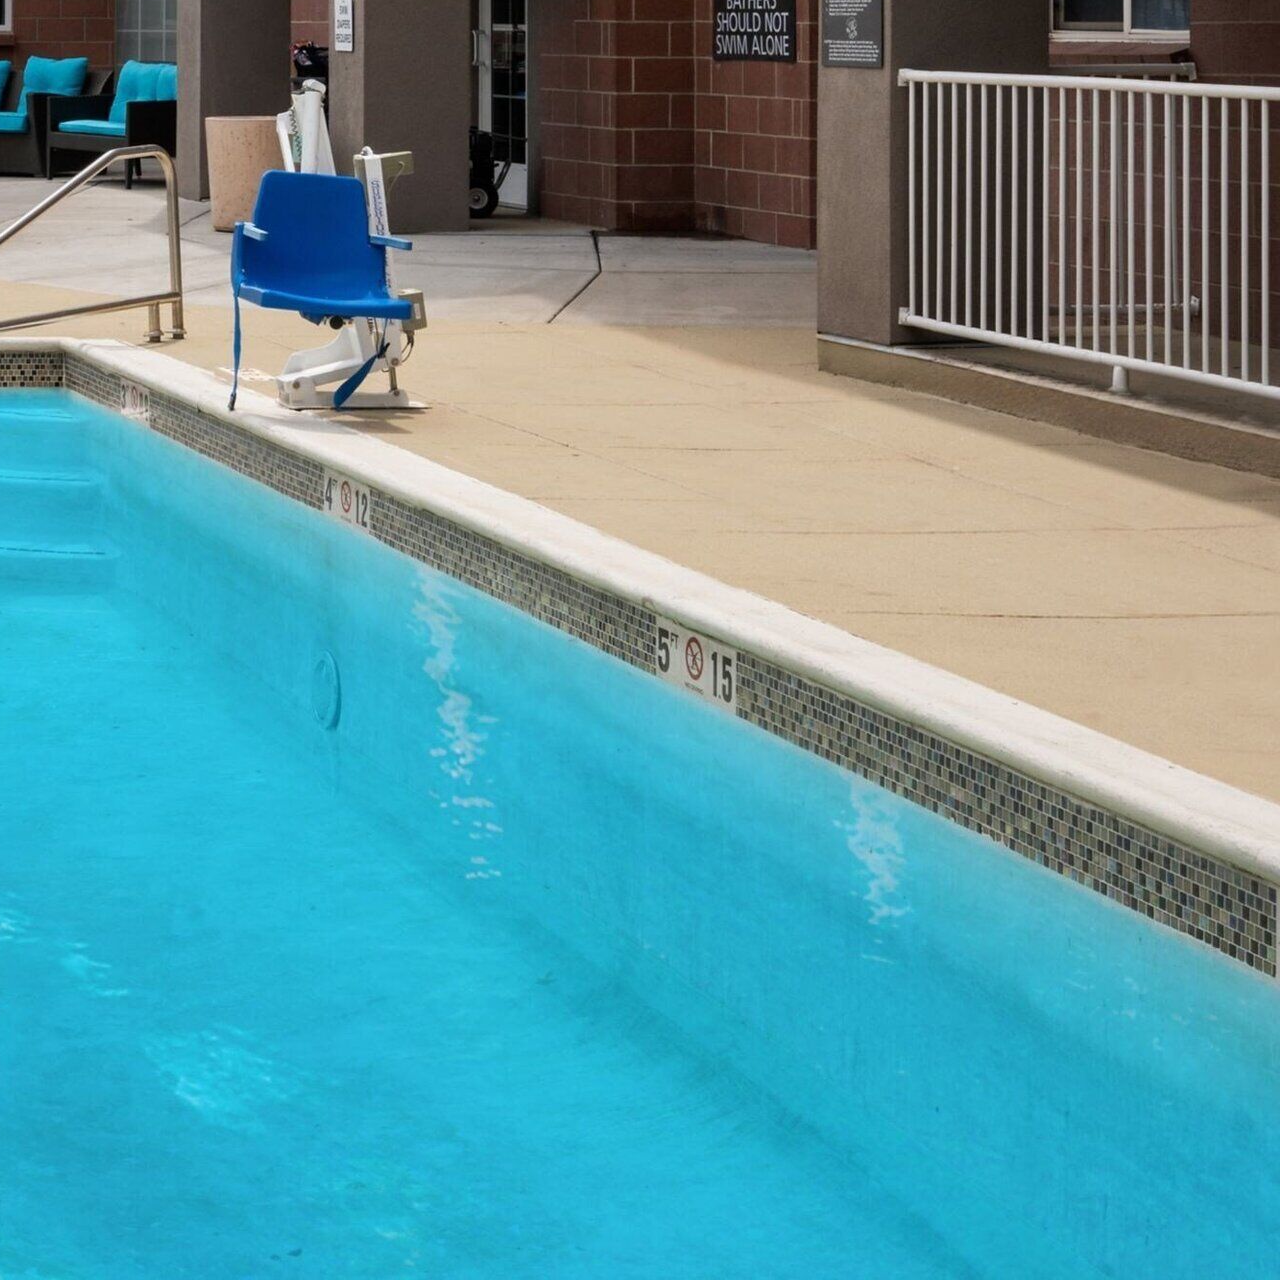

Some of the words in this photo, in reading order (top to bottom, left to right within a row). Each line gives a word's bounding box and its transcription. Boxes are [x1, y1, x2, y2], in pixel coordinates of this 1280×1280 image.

[716, 12, 761, 32] SHOULD
[764, 11, 789, 32] NOT
[716, 34, 748, 55] SWIM
[751, 35, 790, 56] ALONE
